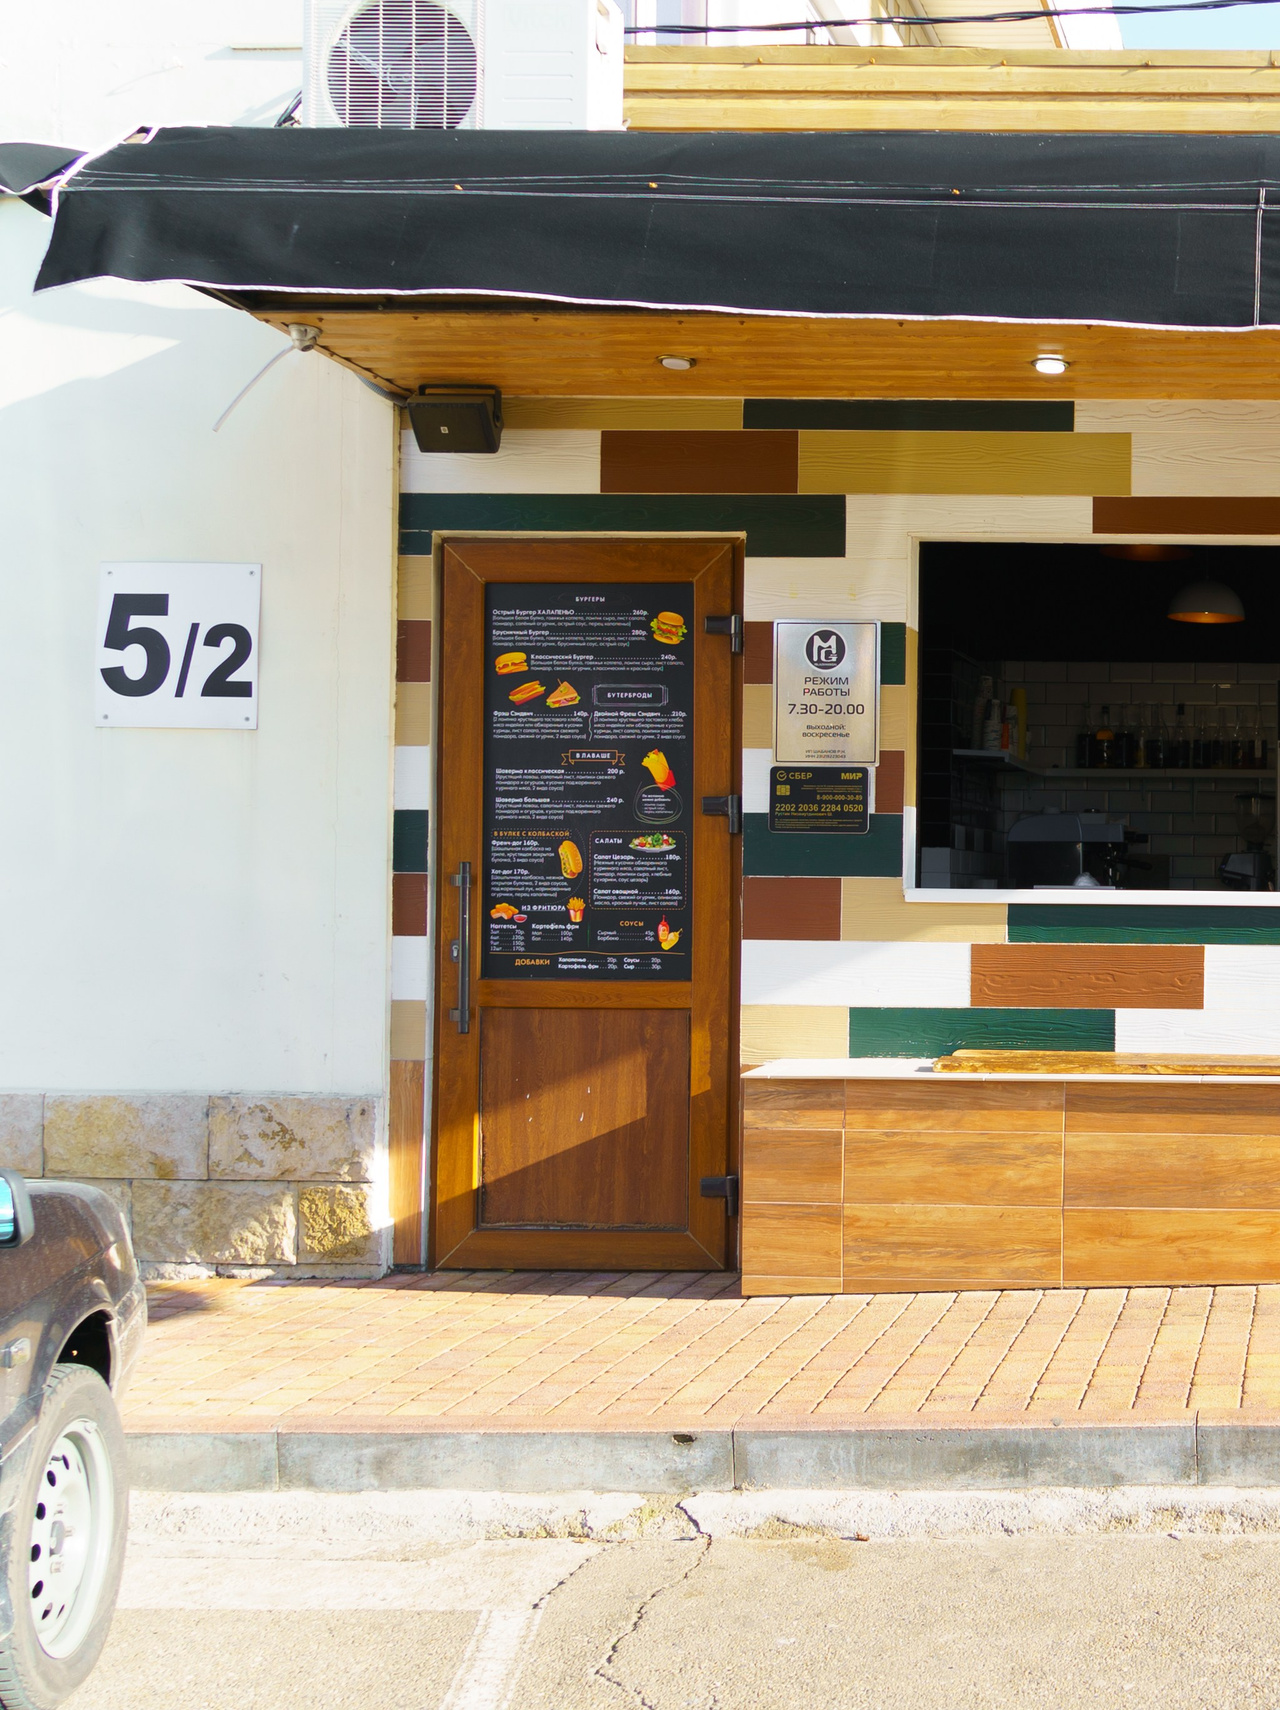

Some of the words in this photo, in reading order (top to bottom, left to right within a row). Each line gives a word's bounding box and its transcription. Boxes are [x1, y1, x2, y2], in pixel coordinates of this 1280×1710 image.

[100, 593, 253, 698] 5/2
[804, 677, 849, 685] РЕЖИМ
[803, 688, 850, 696] РАБОТЫ
[788, 703, 865, 714] 7.30-20.00
